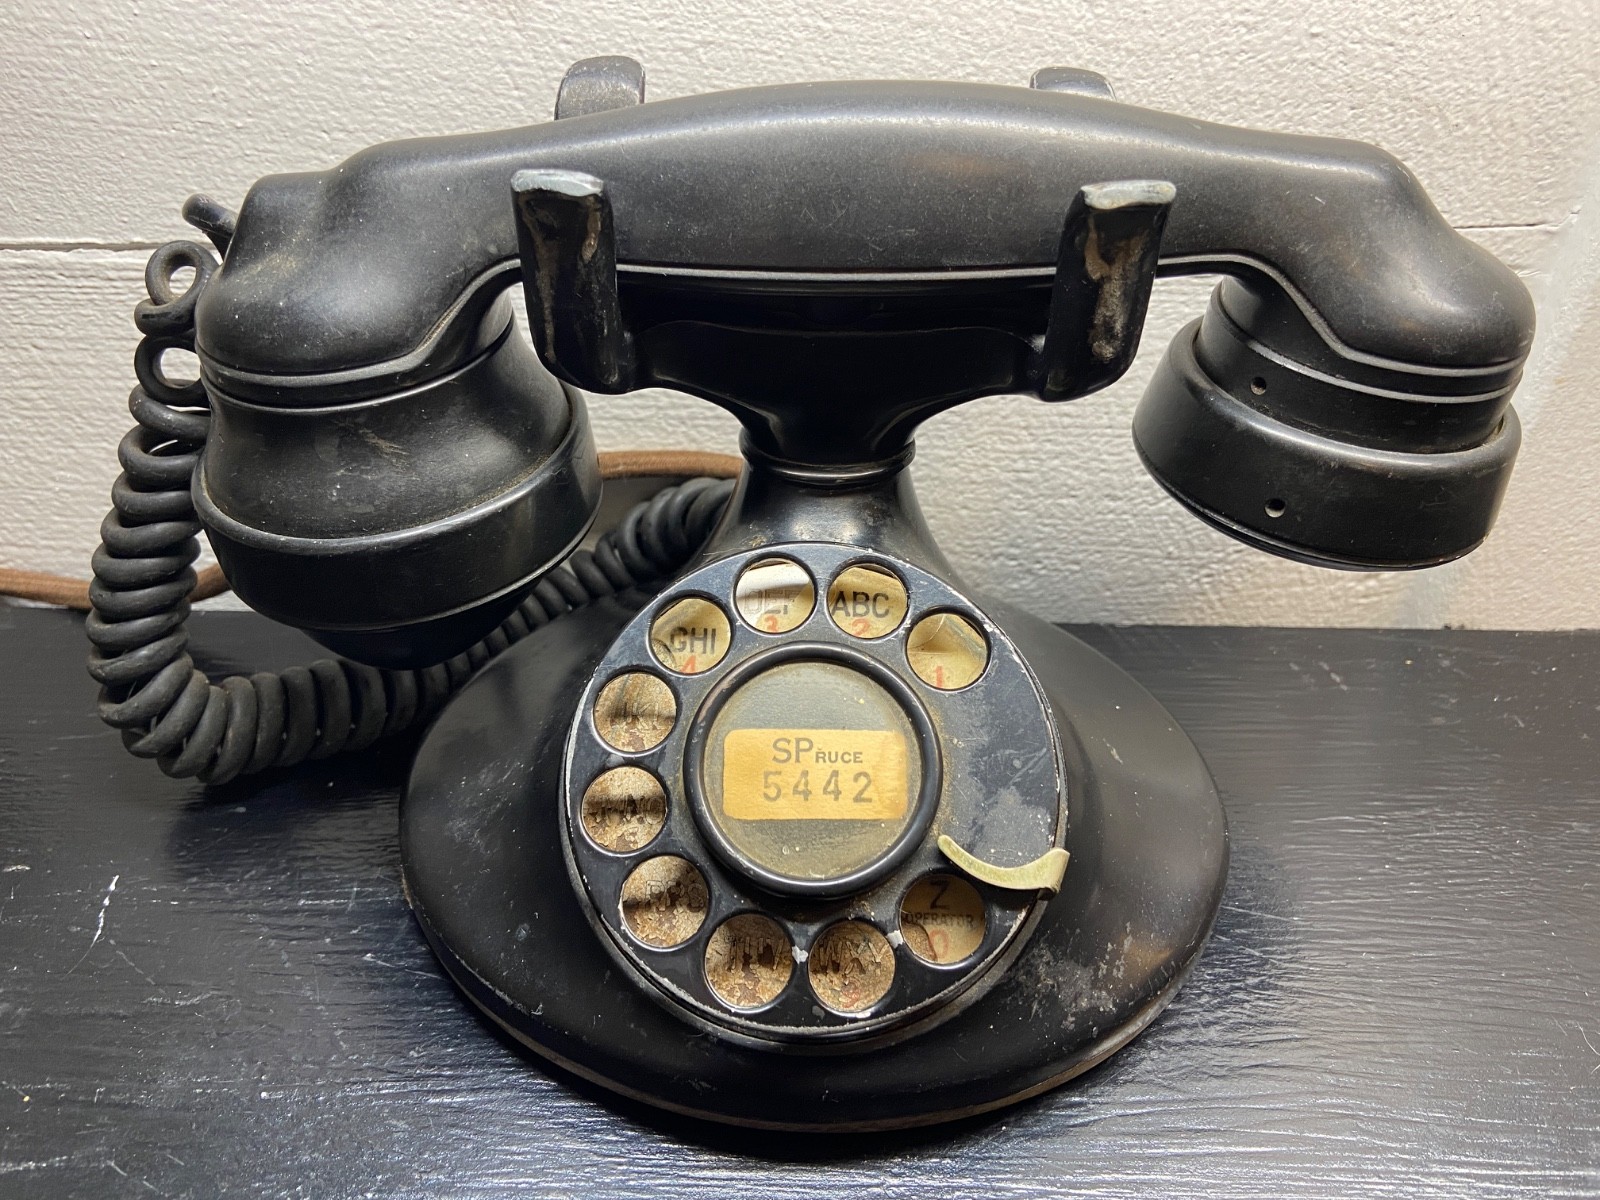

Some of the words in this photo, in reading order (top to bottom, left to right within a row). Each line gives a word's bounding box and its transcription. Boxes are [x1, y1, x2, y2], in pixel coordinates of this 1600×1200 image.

[831, 589, 890, 618] ABC
[670, 627, 717, 655] GHI
[851, 618, 871, 637] 2
[935, 665, 944, 689] 1
[762, 769, 873, 803] 5442
[929, 880, 951, 910] Z
[904, 911, 975, 929] OPERATOR
